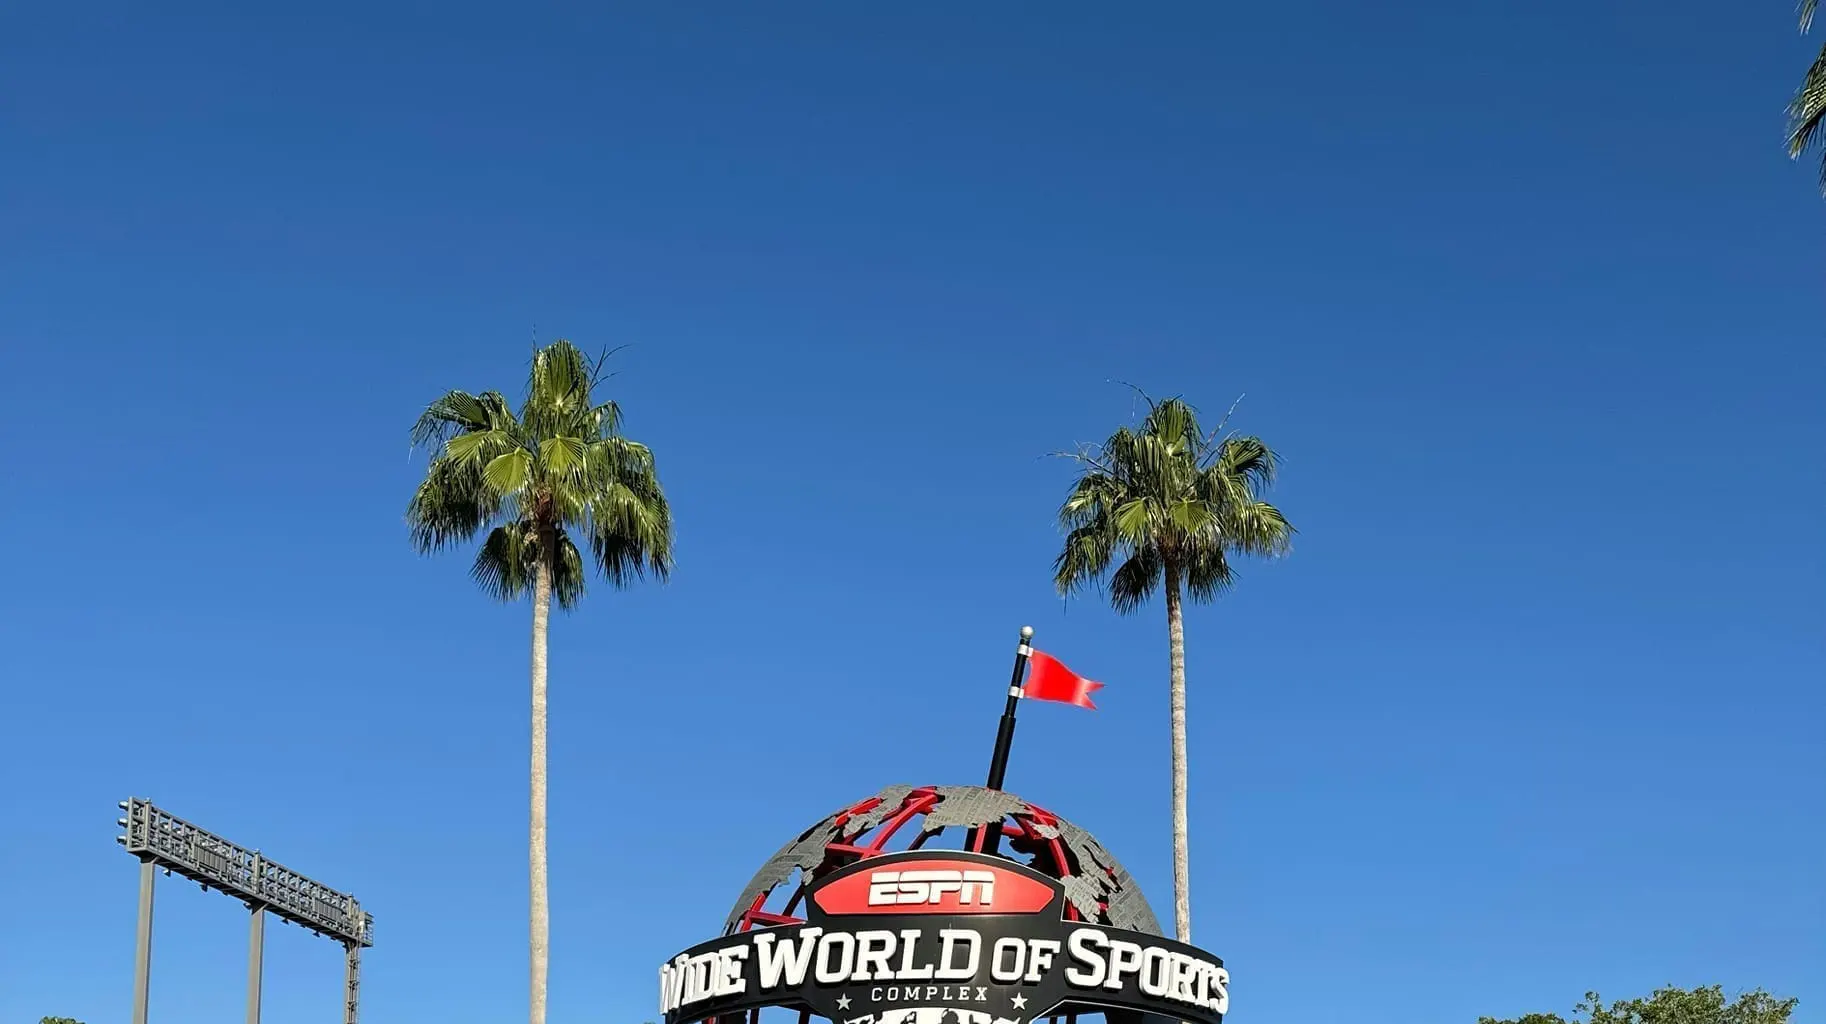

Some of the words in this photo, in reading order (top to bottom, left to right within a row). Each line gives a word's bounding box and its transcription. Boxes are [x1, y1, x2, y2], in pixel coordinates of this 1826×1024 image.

[868, 870, 996, 906] ESPN
[659, 944, 750, 1015] WIDE
[753, 926, 982, 990] WORLD
[990, 936, 1061, 983] OF
[1064, 928, 1231, 1016] SPORTS
[872, 985, 988, 1002] COMPLEX
